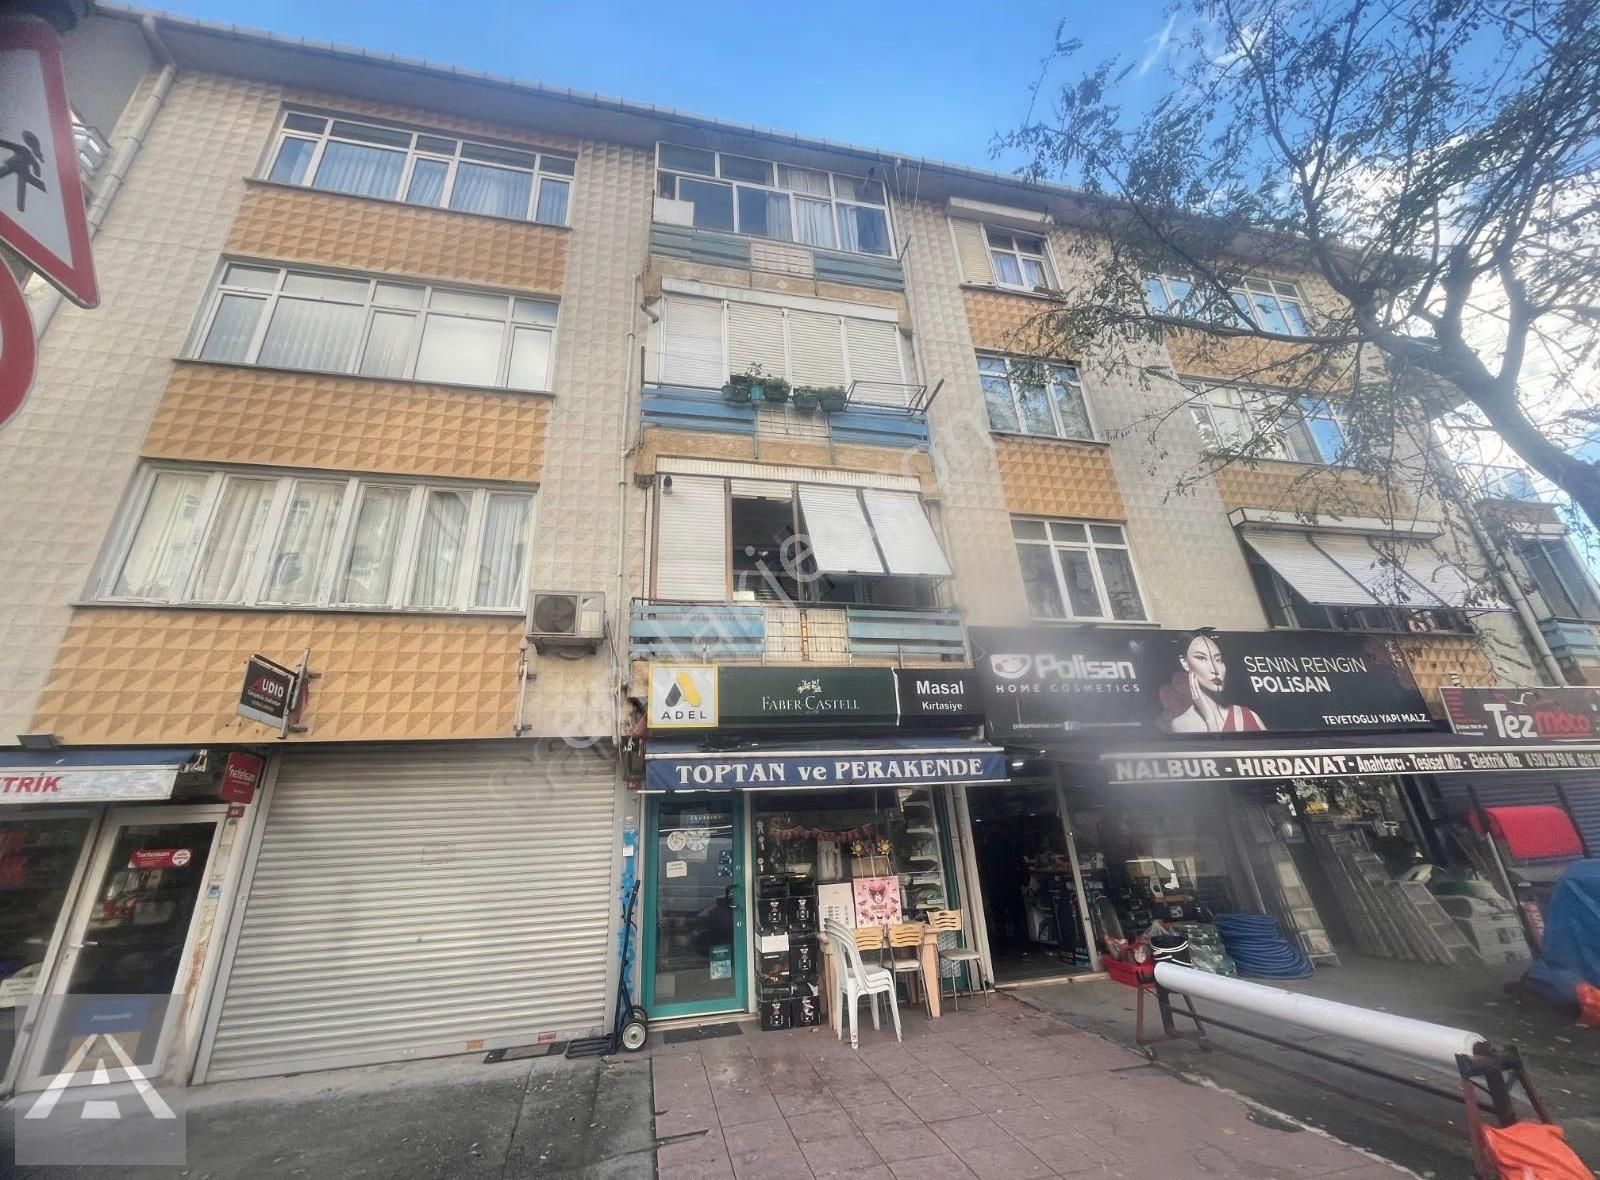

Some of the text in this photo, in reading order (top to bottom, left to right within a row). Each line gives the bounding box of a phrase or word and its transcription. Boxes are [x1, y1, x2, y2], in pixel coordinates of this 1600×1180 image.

[1035, 654, 1136, 680] Polisan
[916, 680, 964, 696] Masal
[995, 683, 1141, 694] HOME COSMETICS
[661, 710, 707, 720] ADEL
[921, 701, 963, 712] Kırtasiye
[1379, 714, 1402, 724] YAPI
[1483, 703, 1538, 739] Tez
[676, 758, 985, 785] TOPTAN ve PERAKENDE
[1115, 758, 1221, 781] NALBUR
[1409, 754, 1446, 771] Tesisat
[1468, 753, 1505, 769] Elektrik
[0, 772, 64, 793] TRİK
